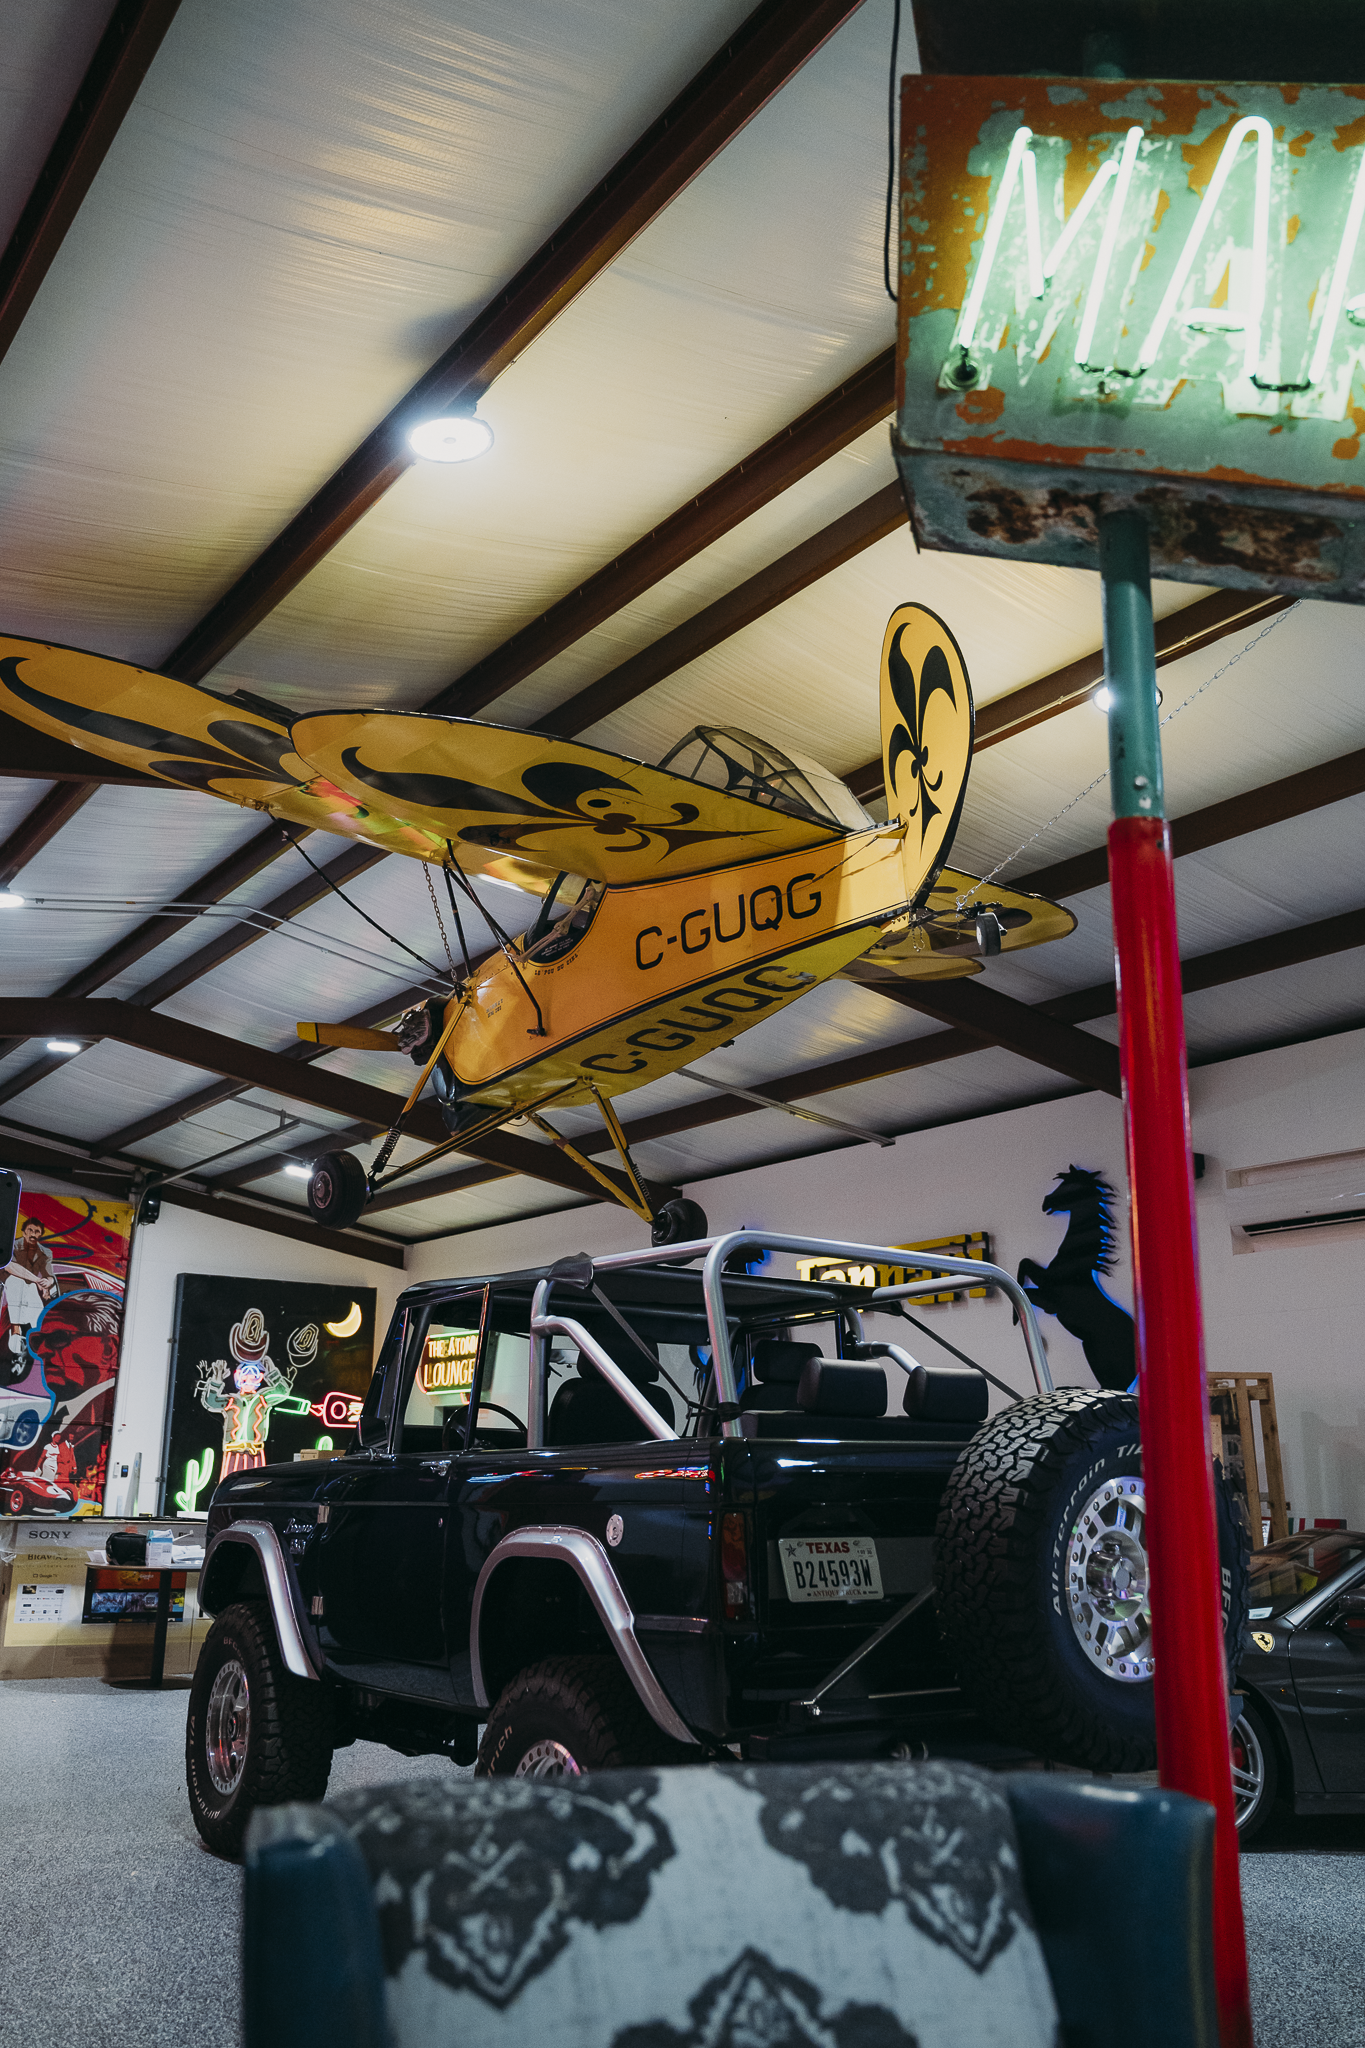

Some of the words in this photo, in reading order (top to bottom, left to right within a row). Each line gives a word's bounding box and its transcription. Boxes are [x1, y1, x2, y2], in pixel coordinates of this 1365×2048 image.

[635, 872, 822, 970] C-GUQG
[579, 964, 817, 1075] C-GUQG
[427, 1340, 445, 1358] THE
[423, 1358, 476, 1388] LOUNGE
[28, 1530, 72, 1539] SONY
[805, 1541, 850, 1554] TEXAS
[1052, 1457, 1106, 1617] All-Terrain
[792, 1559, 873, 1589] B24593W
